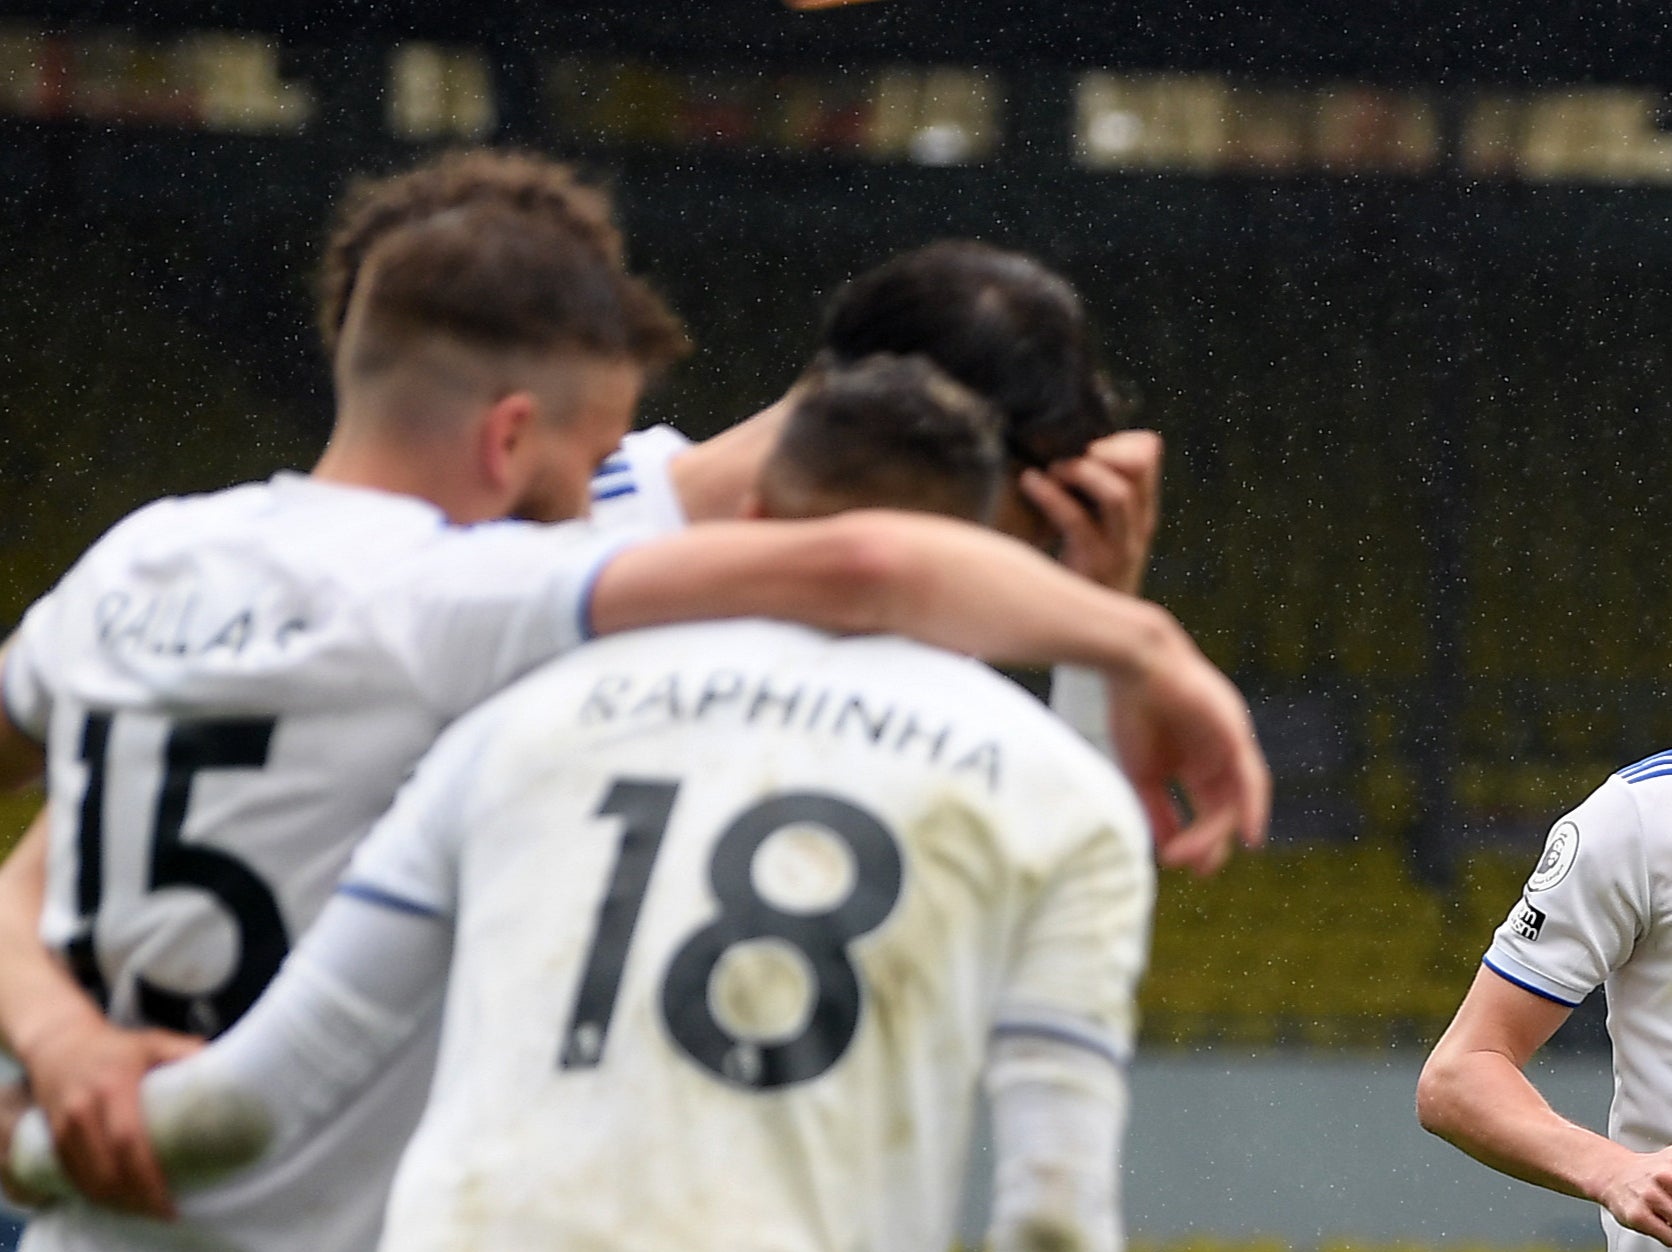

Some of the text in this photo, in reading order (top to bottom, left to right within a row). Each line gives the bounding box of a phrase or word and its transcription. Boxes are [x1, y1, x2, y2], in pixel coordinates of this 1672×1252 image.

[66, 708, 291, 1043] 15
[580, 670, 1006, 793] RAPHINHA
[558, 774, 906, 1092] 18
